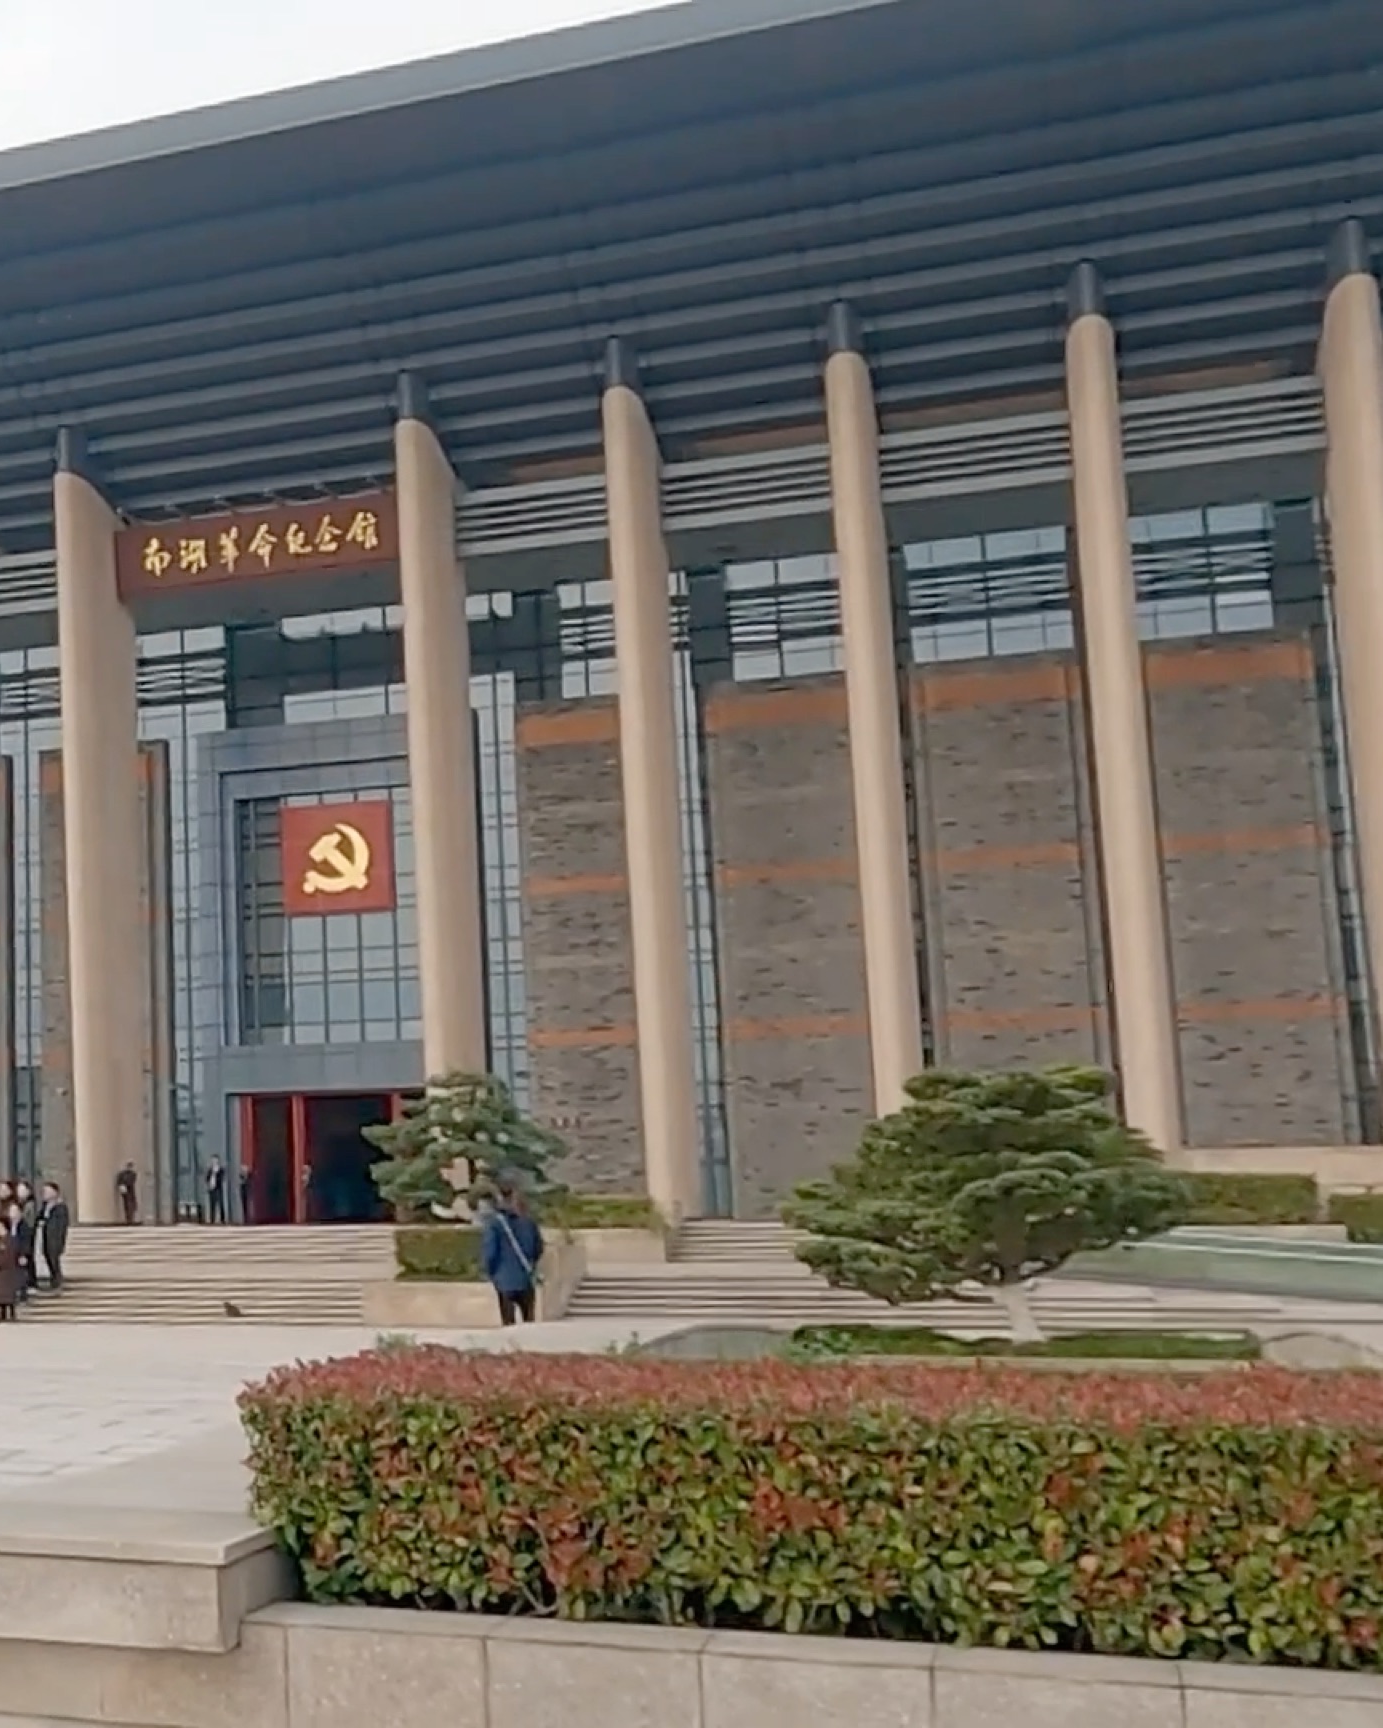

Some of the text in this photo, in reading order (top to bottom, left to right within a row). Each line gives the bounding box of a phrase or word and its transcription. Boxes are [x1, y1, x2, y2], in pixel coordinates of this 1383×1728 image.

[143, 511, 378, 577] 南湖革命纪念馆
